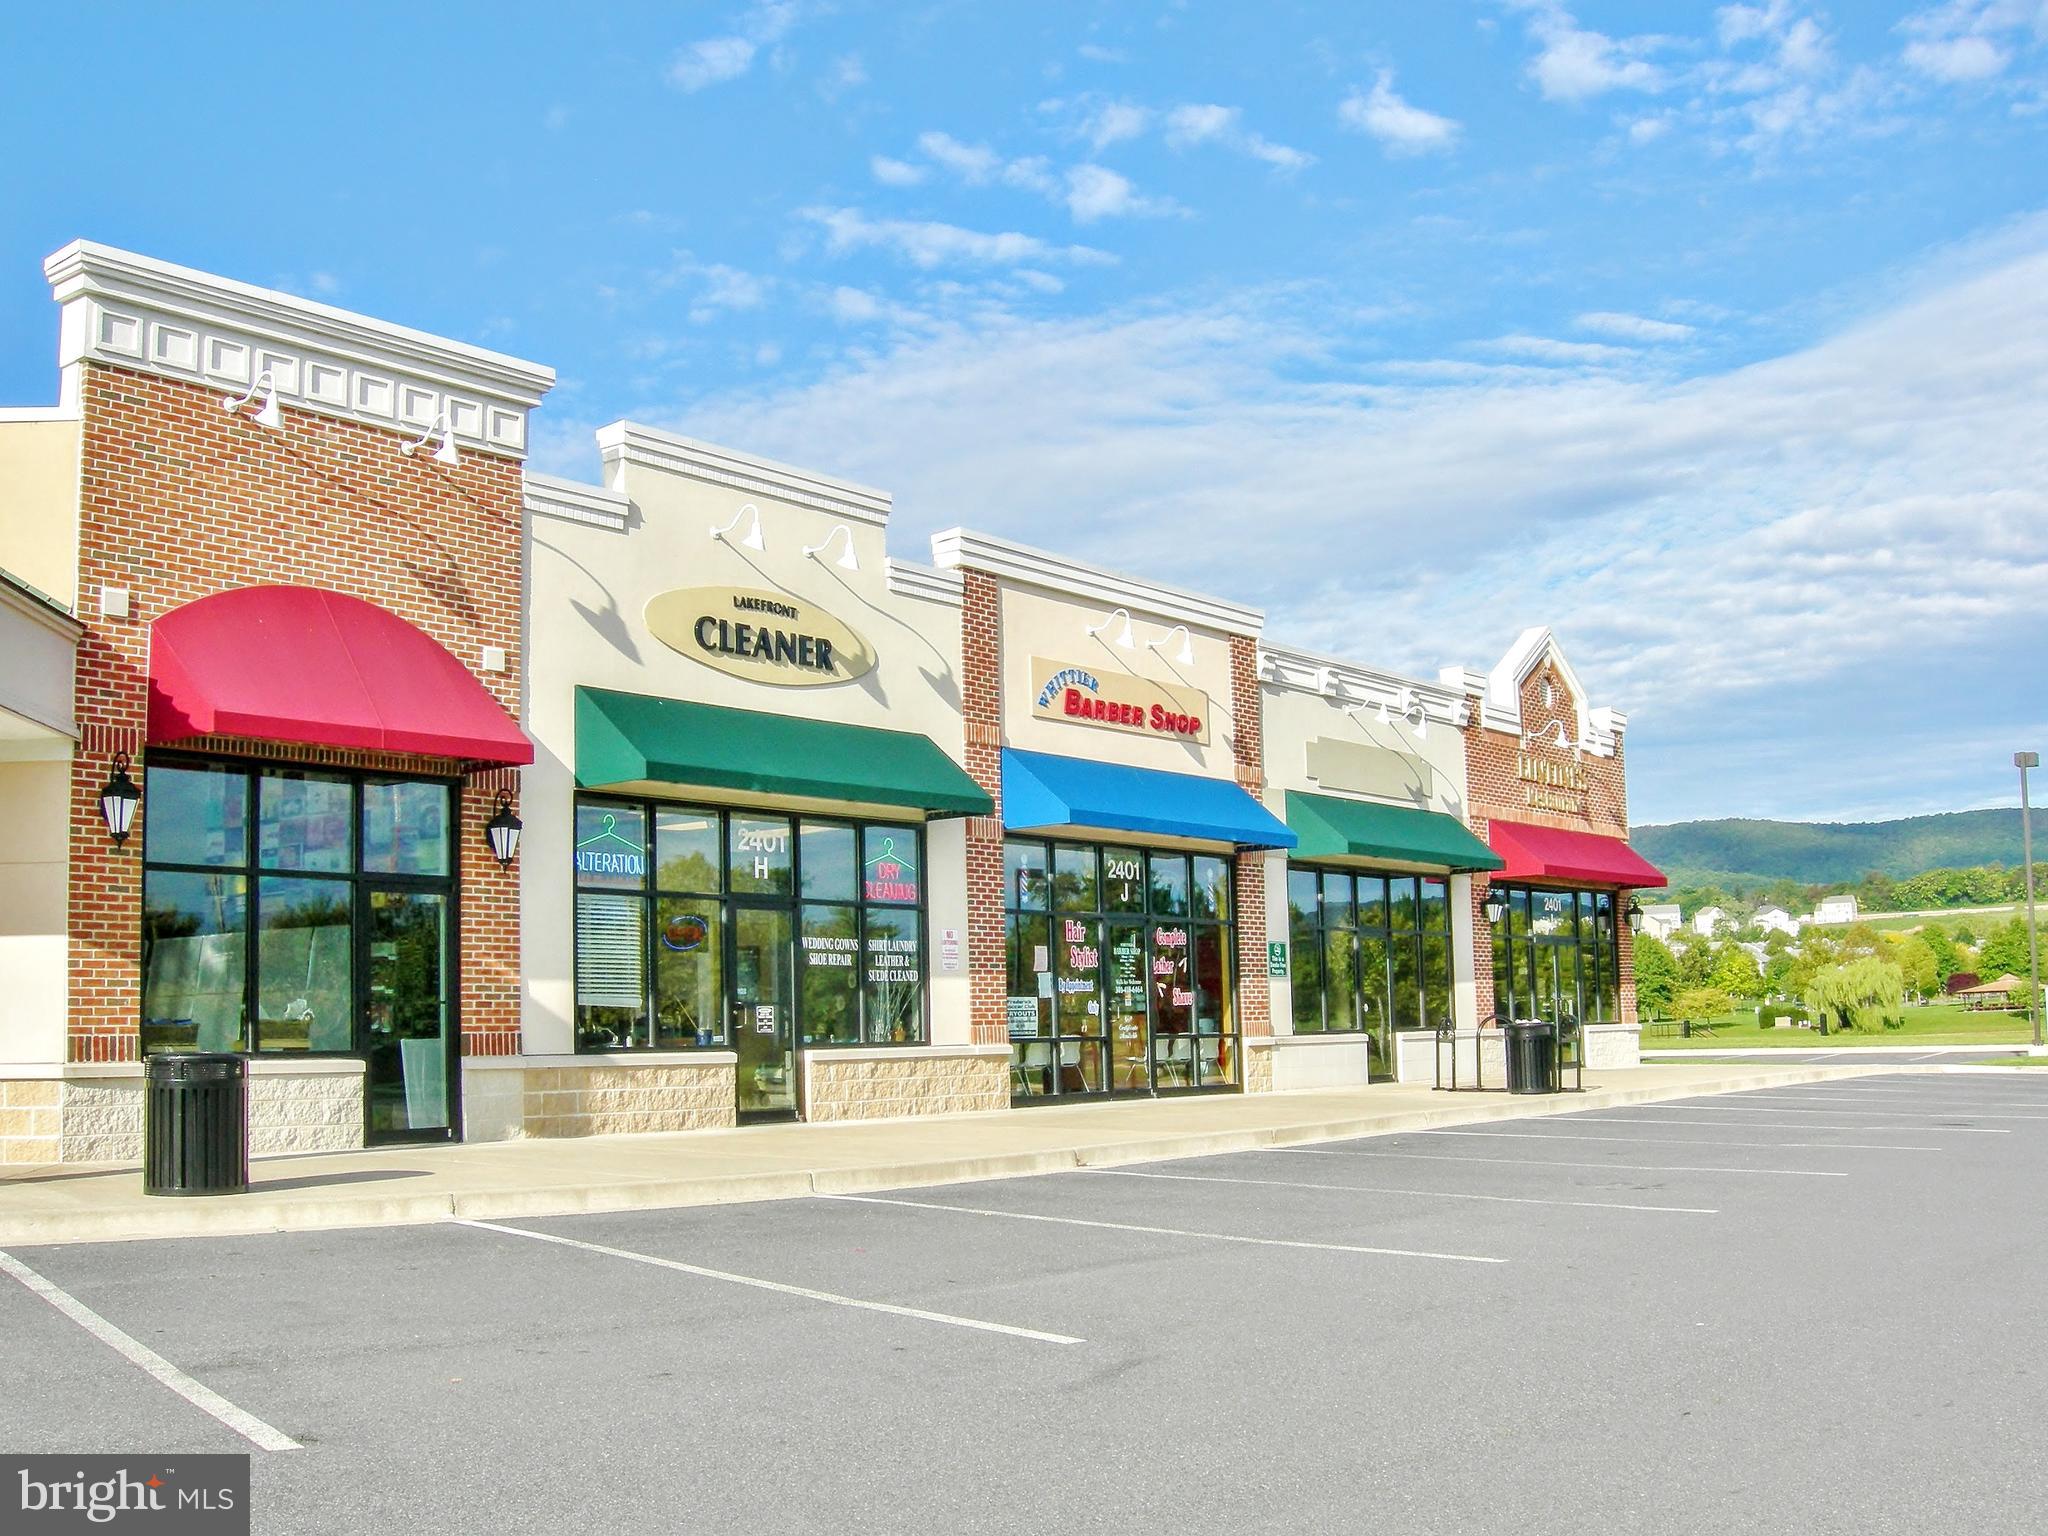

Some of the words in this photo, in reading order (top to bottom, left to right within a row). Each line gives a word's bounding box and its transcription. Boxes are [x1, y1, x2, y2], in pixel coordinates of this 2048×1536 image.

[733, 595, 798, 619] LAKEFRONT
[694, 616, 834, 671] CLEANER
[1037, 668, 1099, 709] WHITTIER
[1064, 688, 1145, 728] BARBER
[1150, 703, 1201, 735] SHOP
[738, 828, 785, 853] 2401
[754, 856, 769, 880] H
[878, 862, 901, 880] DRY
[1107, 859, 1140, 881] 2401
[1120, 882, 1129, 902] J
[1543, 897, 1562, 912] 2401
[1065, 920, 1086, 942] Hair
[1156, 927, 1187, 948] Complete
[801, 936, 834, 950] WEDDING
[834, 938, 859, 951] GOWNS
[868, 939, 887, 952] SHIRT
[888, 939, 917, 952] LAUNDRY
[809, 952, 828, 965] SHOE
[828, 953, 852, 966] REPAIR
[875, 954, 903, 967] LEATHER
[1070, 945, 1098, 971] Stylist
[868, 969, 888, 982] SUEDE
[889, 969, 919, 982] CLEANED
[1172, 987, 1193, 1006] Shave
